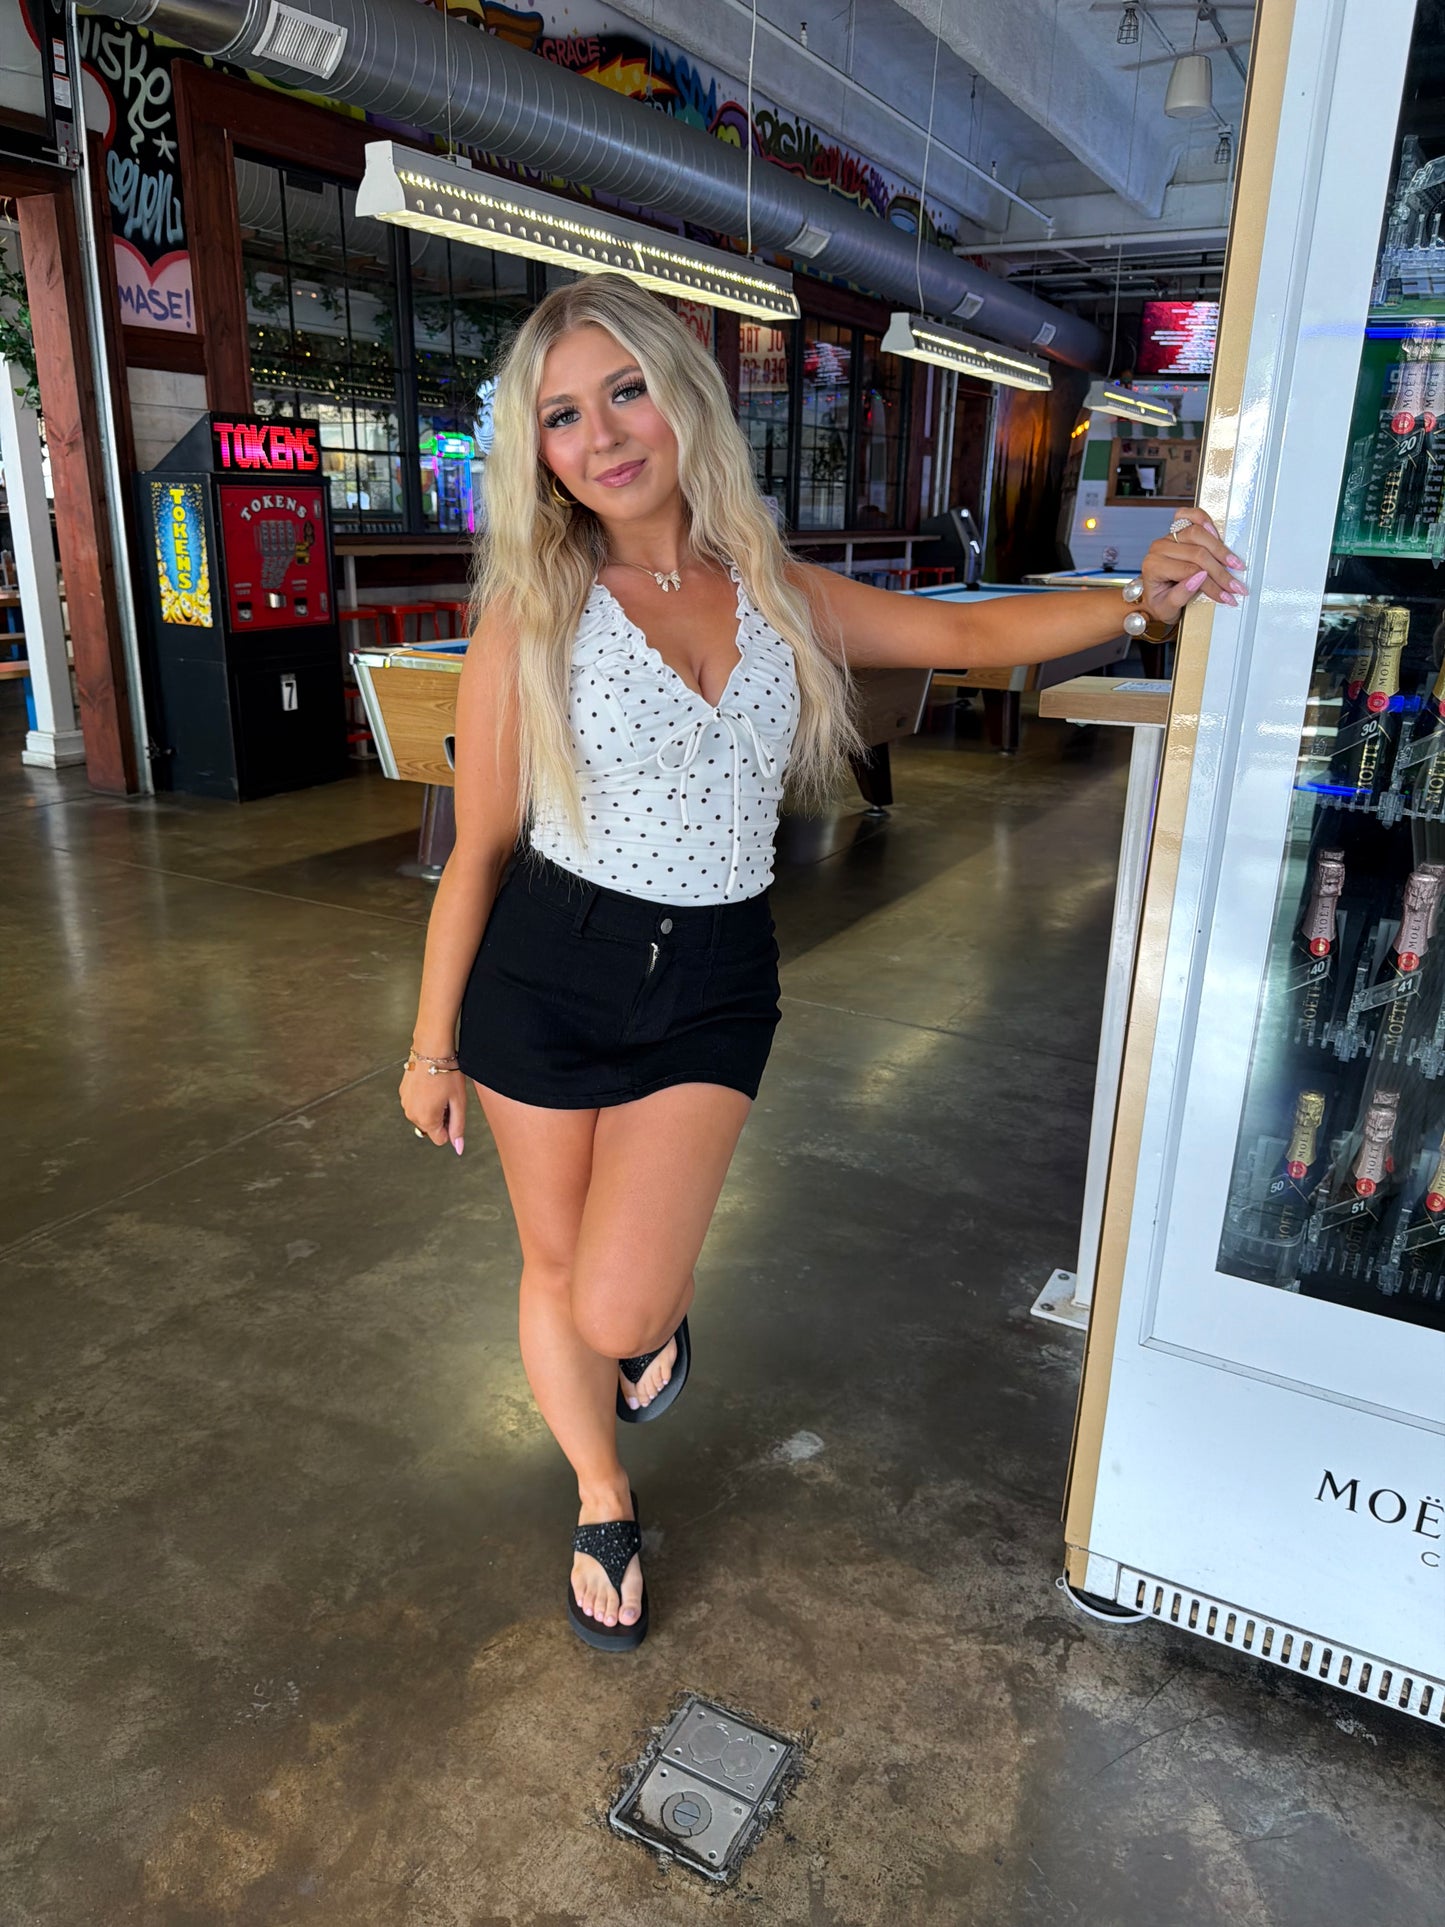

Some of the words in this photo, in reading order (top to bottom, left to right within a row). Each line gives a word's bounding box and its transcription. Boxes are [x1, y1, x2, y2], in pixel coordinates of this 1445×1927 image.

[542, 34, 600, 67] GRACE
[213, 422, 320, 471] TOKENS
[1398, 436, 1417, 455] 20
[240, 495, 307, 521] TOKENS
[169, 488, 193, 590] TOKENS
[285, 682, 295, 707] 7
[1360, 720, 1377, 737] 30
[1310, 960, 1325, 975] 40
[1397, 978, 1413, 992] 41
[1270, 1180, 1284, 1193] 50
[1351, 1200, 1364, 1214] 51
[1314, 1468, 1445, 1539] MOË
